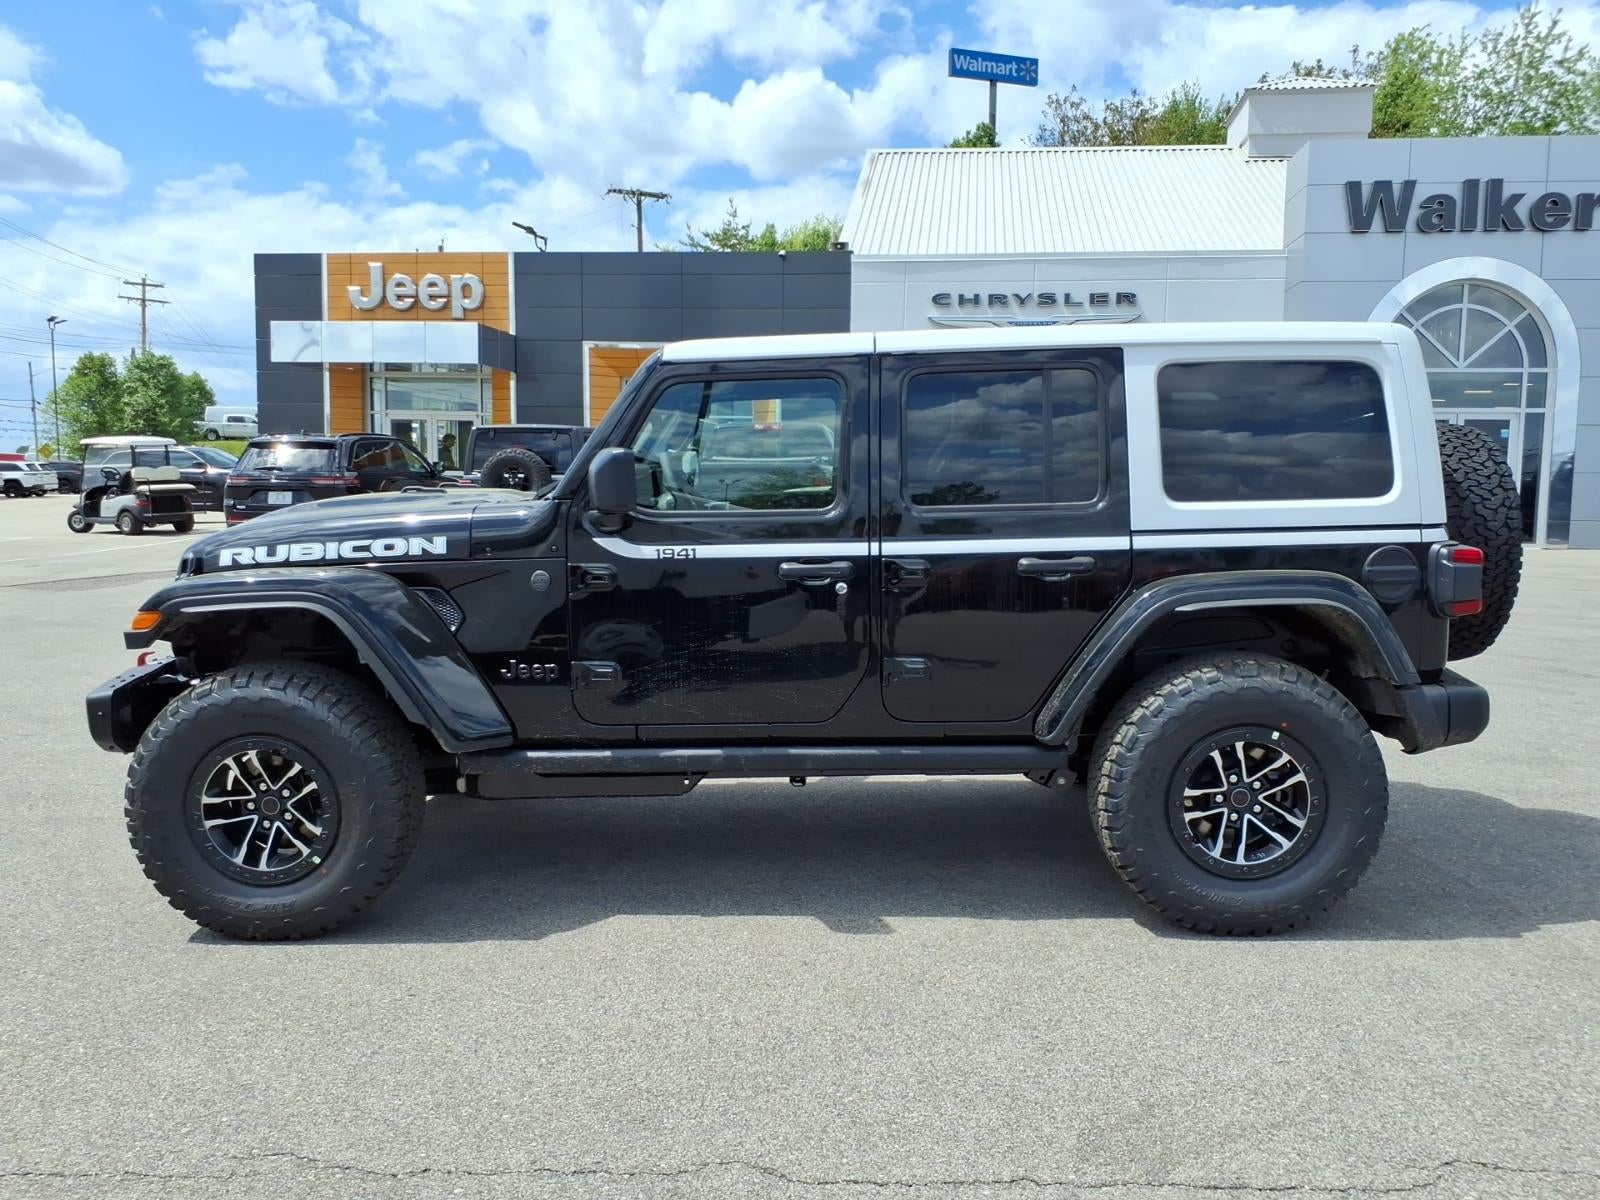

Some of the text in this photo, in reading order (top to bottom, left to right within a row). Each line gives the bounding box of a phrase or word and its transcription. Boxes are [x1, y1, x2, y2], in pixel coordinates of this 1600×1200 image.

[953, 53, 1018, 77] Walmart
[1345, 178, 1600, 232] Walker
[347, 261, 485, 319] Jeep
[931, 292, 1138, 307] CHRYSLER
[219, 536, 448, 567] RUBICON
[655, 547, 697, 560] 1941
[500, 659, 560, 682] Jeep
